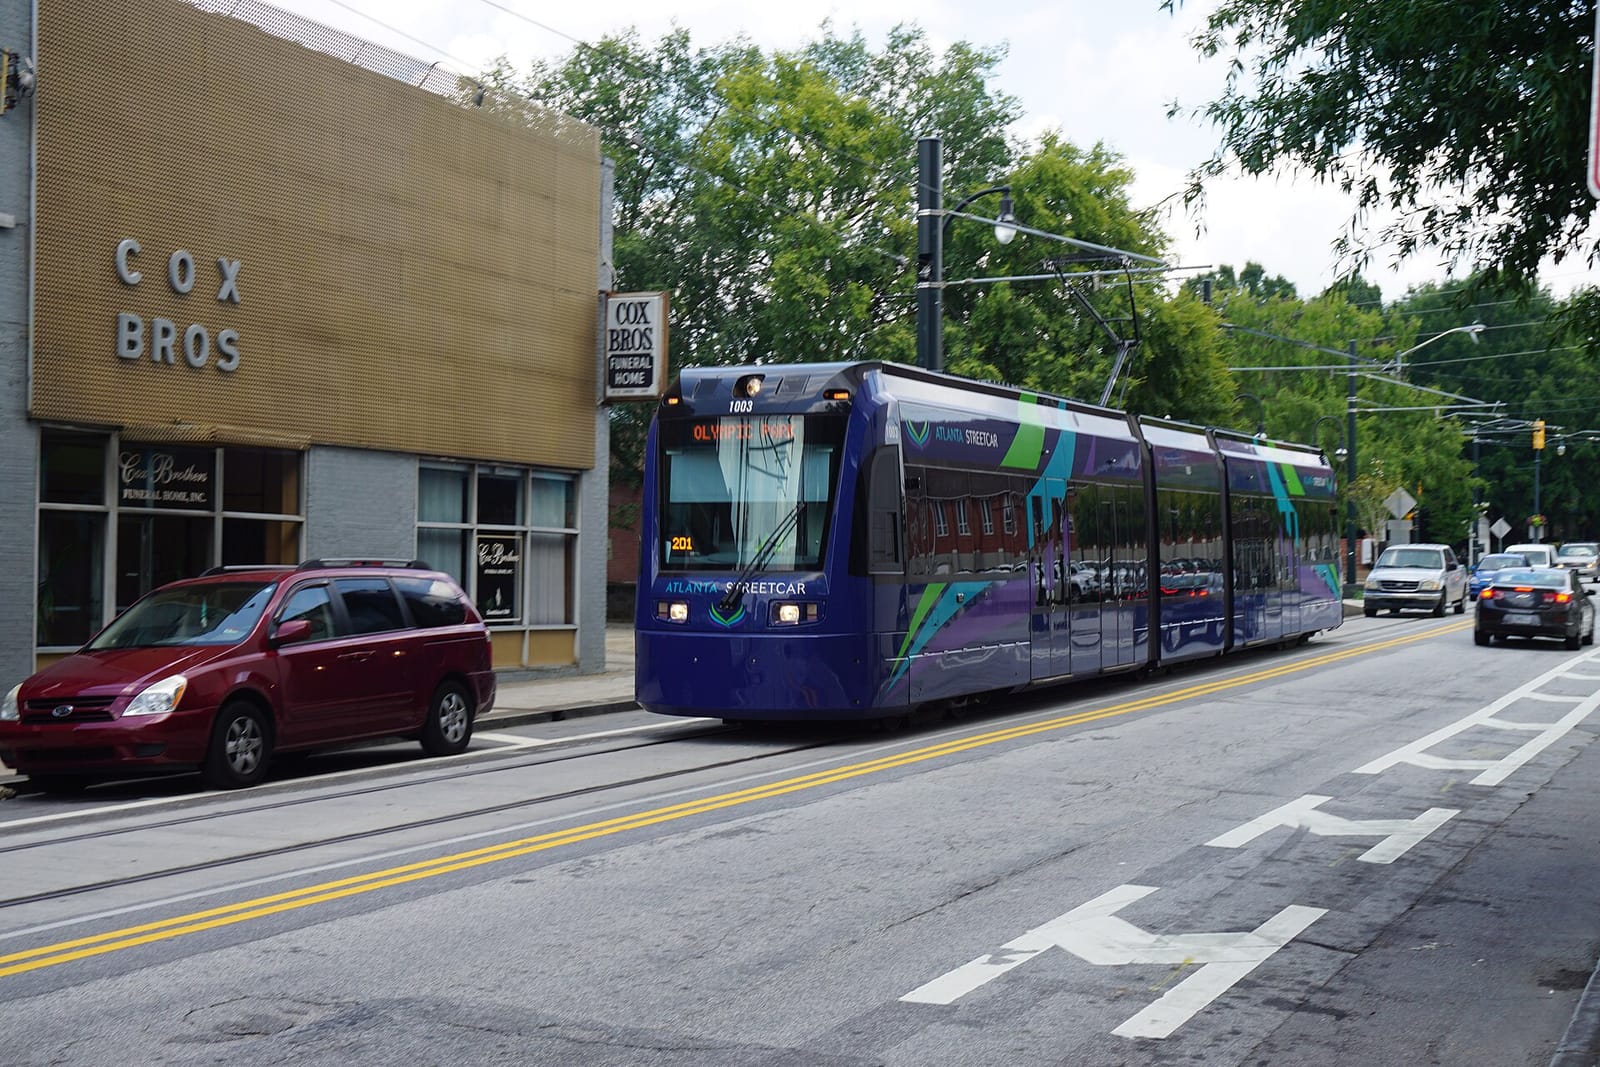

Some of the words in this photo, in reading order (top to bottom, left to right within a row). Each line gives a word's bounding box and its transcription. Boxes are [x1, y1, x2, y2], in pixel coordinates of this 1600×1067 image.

[116, 239, 241, 303] COX
[616, 302, 651, 325] COX
[117, 312, 241, 371] BROS
[608, 327, 653, 351] BROS
[609, 356, 652, 369] FUNERAL
[614, 371, 646, 385] HOME
[729, 400, 753, 413] 1003
[693, 424, 753, 440] OLYMPIC
[936, 426, 964, 443] ATLANTA
[965, 429, 998, 449] STREETCAR
[672, 537, 692, 550] 201
[666, 582, 718, 593] ATLANTA
[725, 582, 806, 595] STREETCAR
